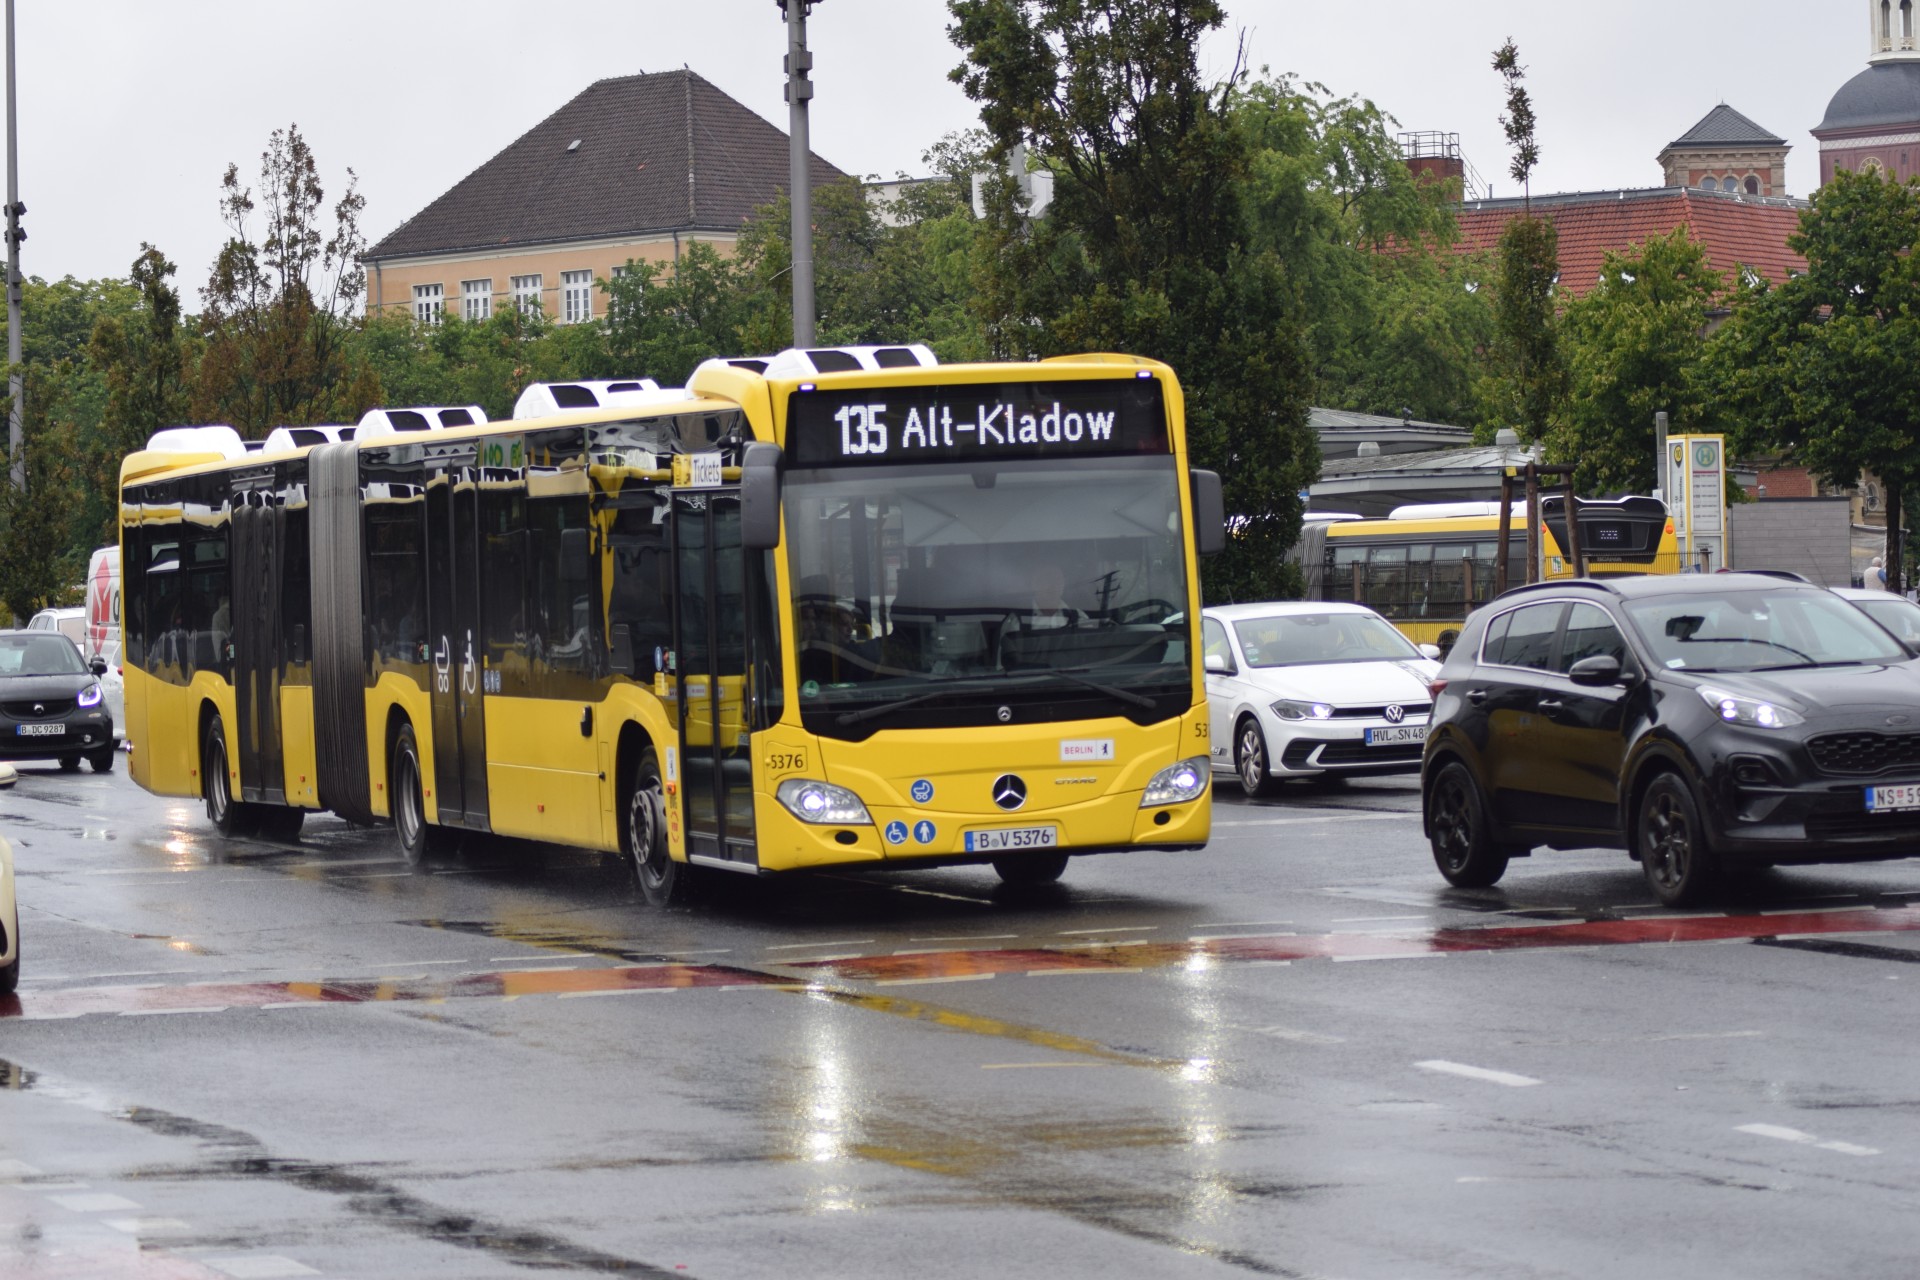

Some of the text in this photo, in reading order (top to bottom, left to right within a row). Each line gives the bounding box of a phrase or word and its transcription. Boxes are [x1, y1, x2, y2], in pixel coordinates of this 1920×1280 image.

[834, 402, 1115, 455] 135 Alt-Kladow
[693, 457, 720, 483] Tickets
[21, 724, 64, 734] B DC 9287
[1195, 722, 1210, 738] 53
[1373, 727, 1426, 741] HVL SN 48
[1064, 746, 1094, 755] BERLIN
[771, 754, 804, 769] 5376
[1877, 789, 1895, 805] NS
[980, 829, 1050, 848] B V 5376
